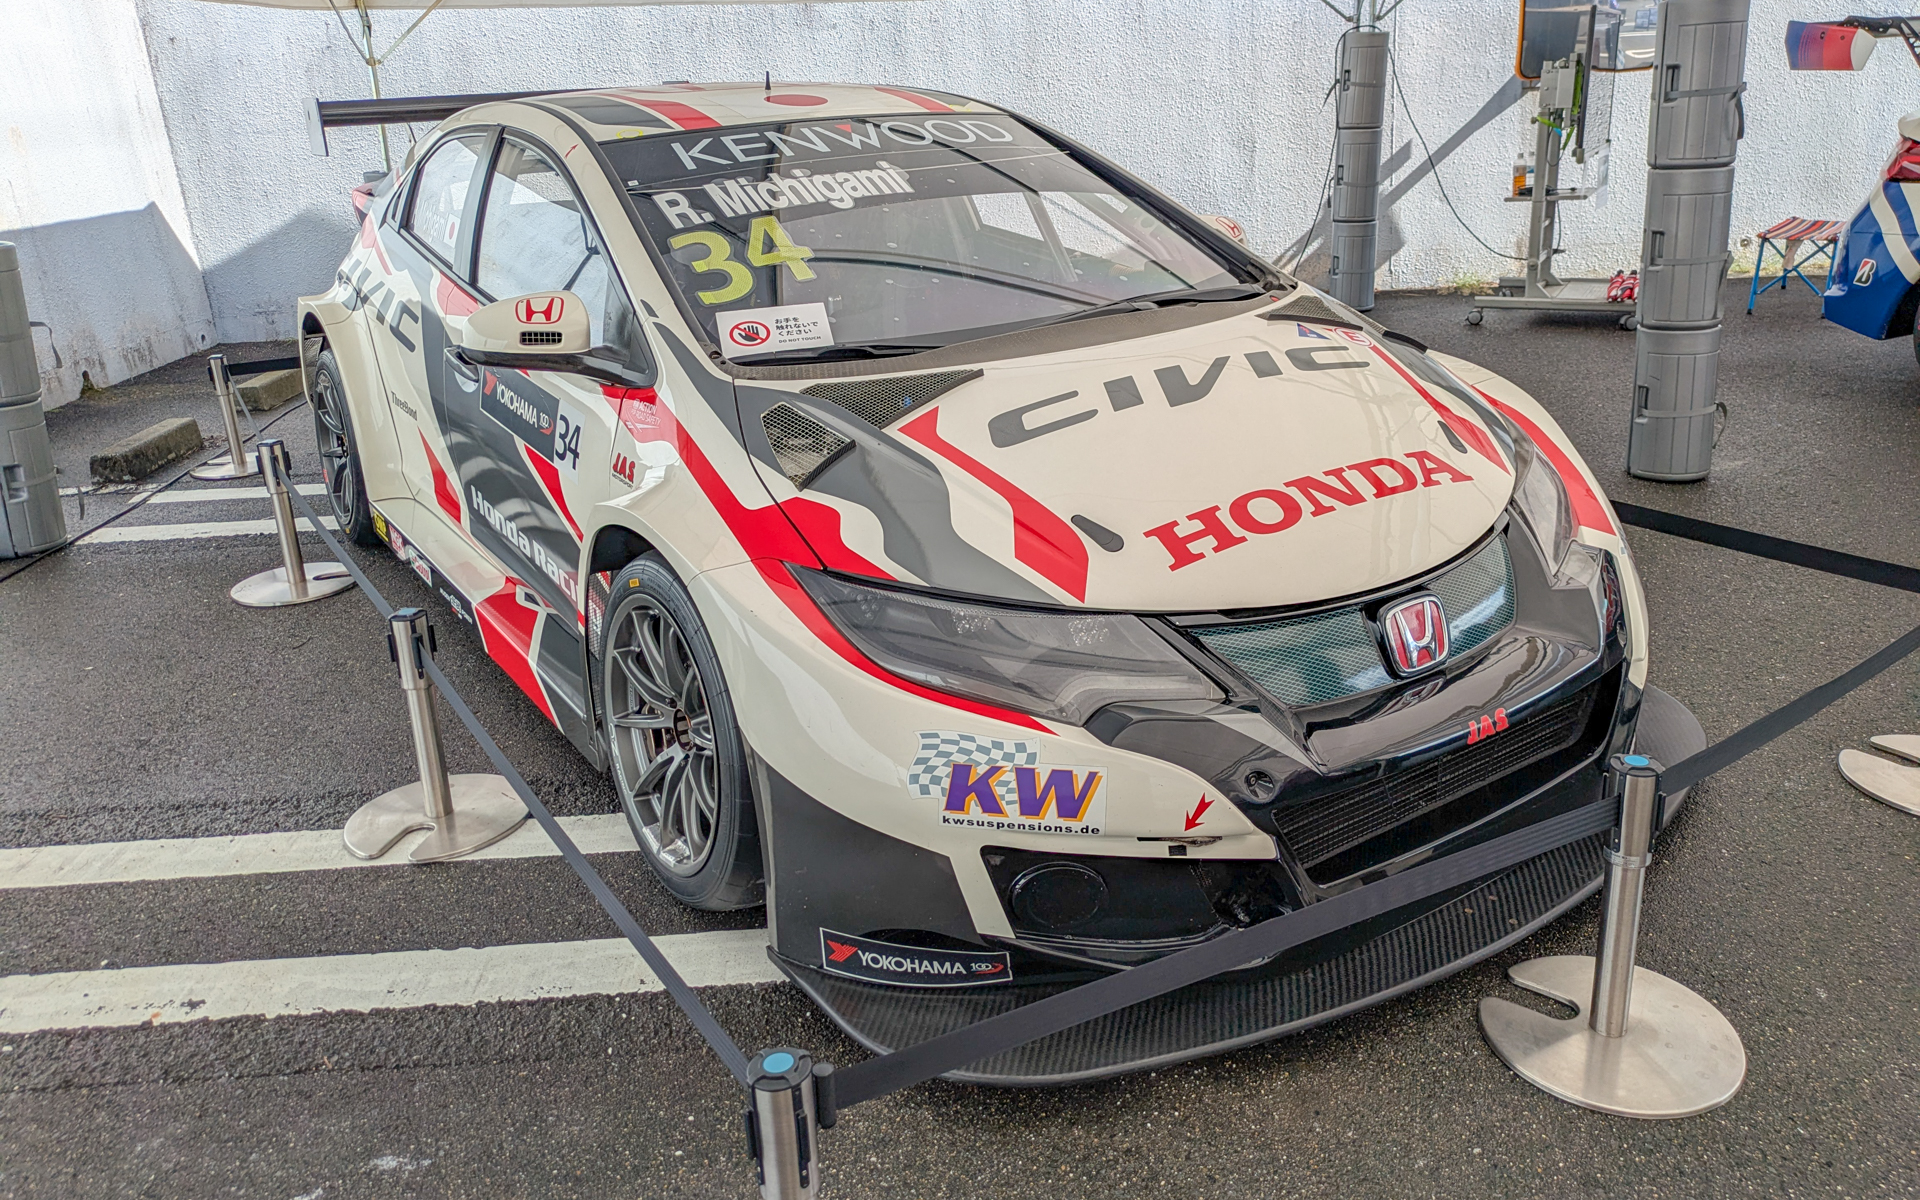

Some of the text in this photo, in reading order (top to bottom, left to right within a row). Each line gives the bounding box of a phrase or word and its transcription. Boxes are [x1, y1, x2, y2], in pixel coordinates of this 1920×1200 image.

[671, 120, 1013, 171] KENWOOD
[652, 161, 914, 230] R. Michigami
[668, 216, 816, 306] 34
[776, 321, 818, 330] 触れないで
[778, 328, 812, 337] ください
[496, 380, 538, 429] YOKOHAMA
[639, 400, 657, 415] ACTION
[646, 412, 662, 426] SAFETY
[987, 345, 1371, 449] CIVIC
[555, 413, 582, 471] 34
[612, 452, 636, 484] JAS
[1143, 449, 1474, 573] HONDA
[471, 484, 579, 603] Honda Raci
[1466, 708, 1510, 746] JAS
[943, 761, 1104, 823] KW
[941, 814, 1101, 836] kwsuspensions.de
[857, 949, 968, 975] YOKOHAMA
